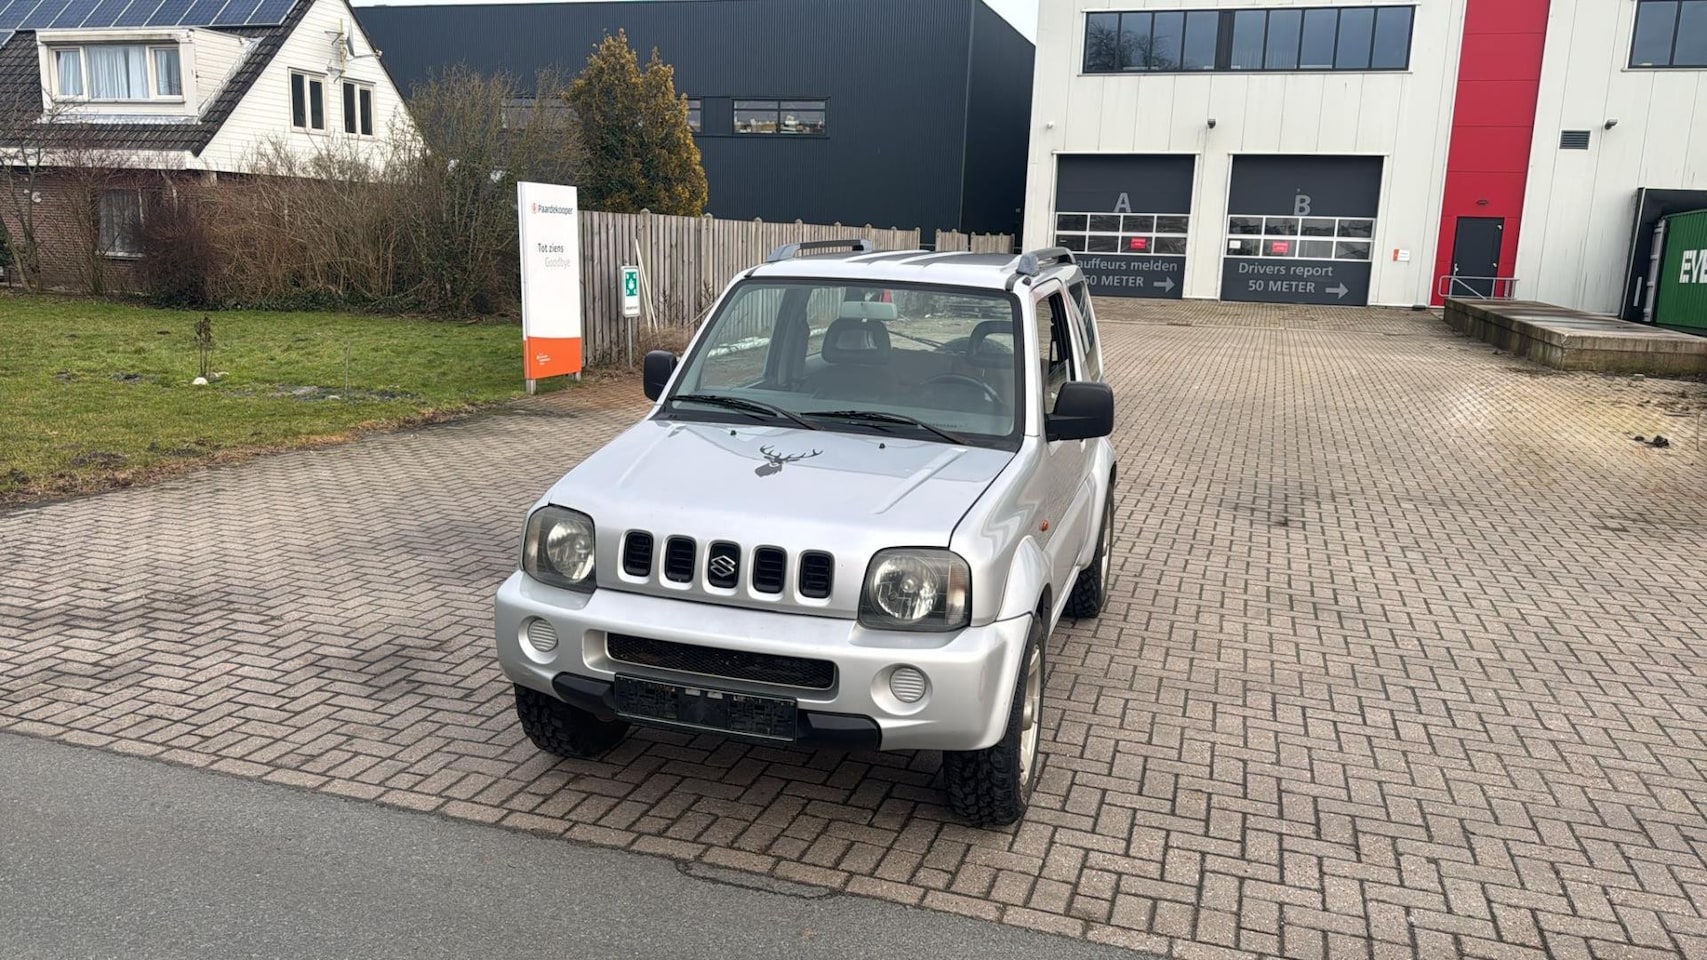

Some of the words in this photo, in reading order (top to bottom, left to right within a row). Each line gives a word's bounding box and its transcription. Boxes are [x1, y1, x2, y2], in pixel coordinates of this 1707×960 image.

[1113, 192, 1132, 213] A
[1293, 194, 1311, 216] B
[537, 243, 548, 253] Tot
[549, 243, 564, 253] ziens
[1078, 258, 1127, 270] auffeurs
[1130, 259, 1177, 272] melden
[1238, 262, 1286, 275] Drivers
[1290, 266, 1333, 281] report
[1101, 275, 1144, 287] METER
[1248, 280, 1264, 291] 50
[1268, 281, 1315, 293] METER
